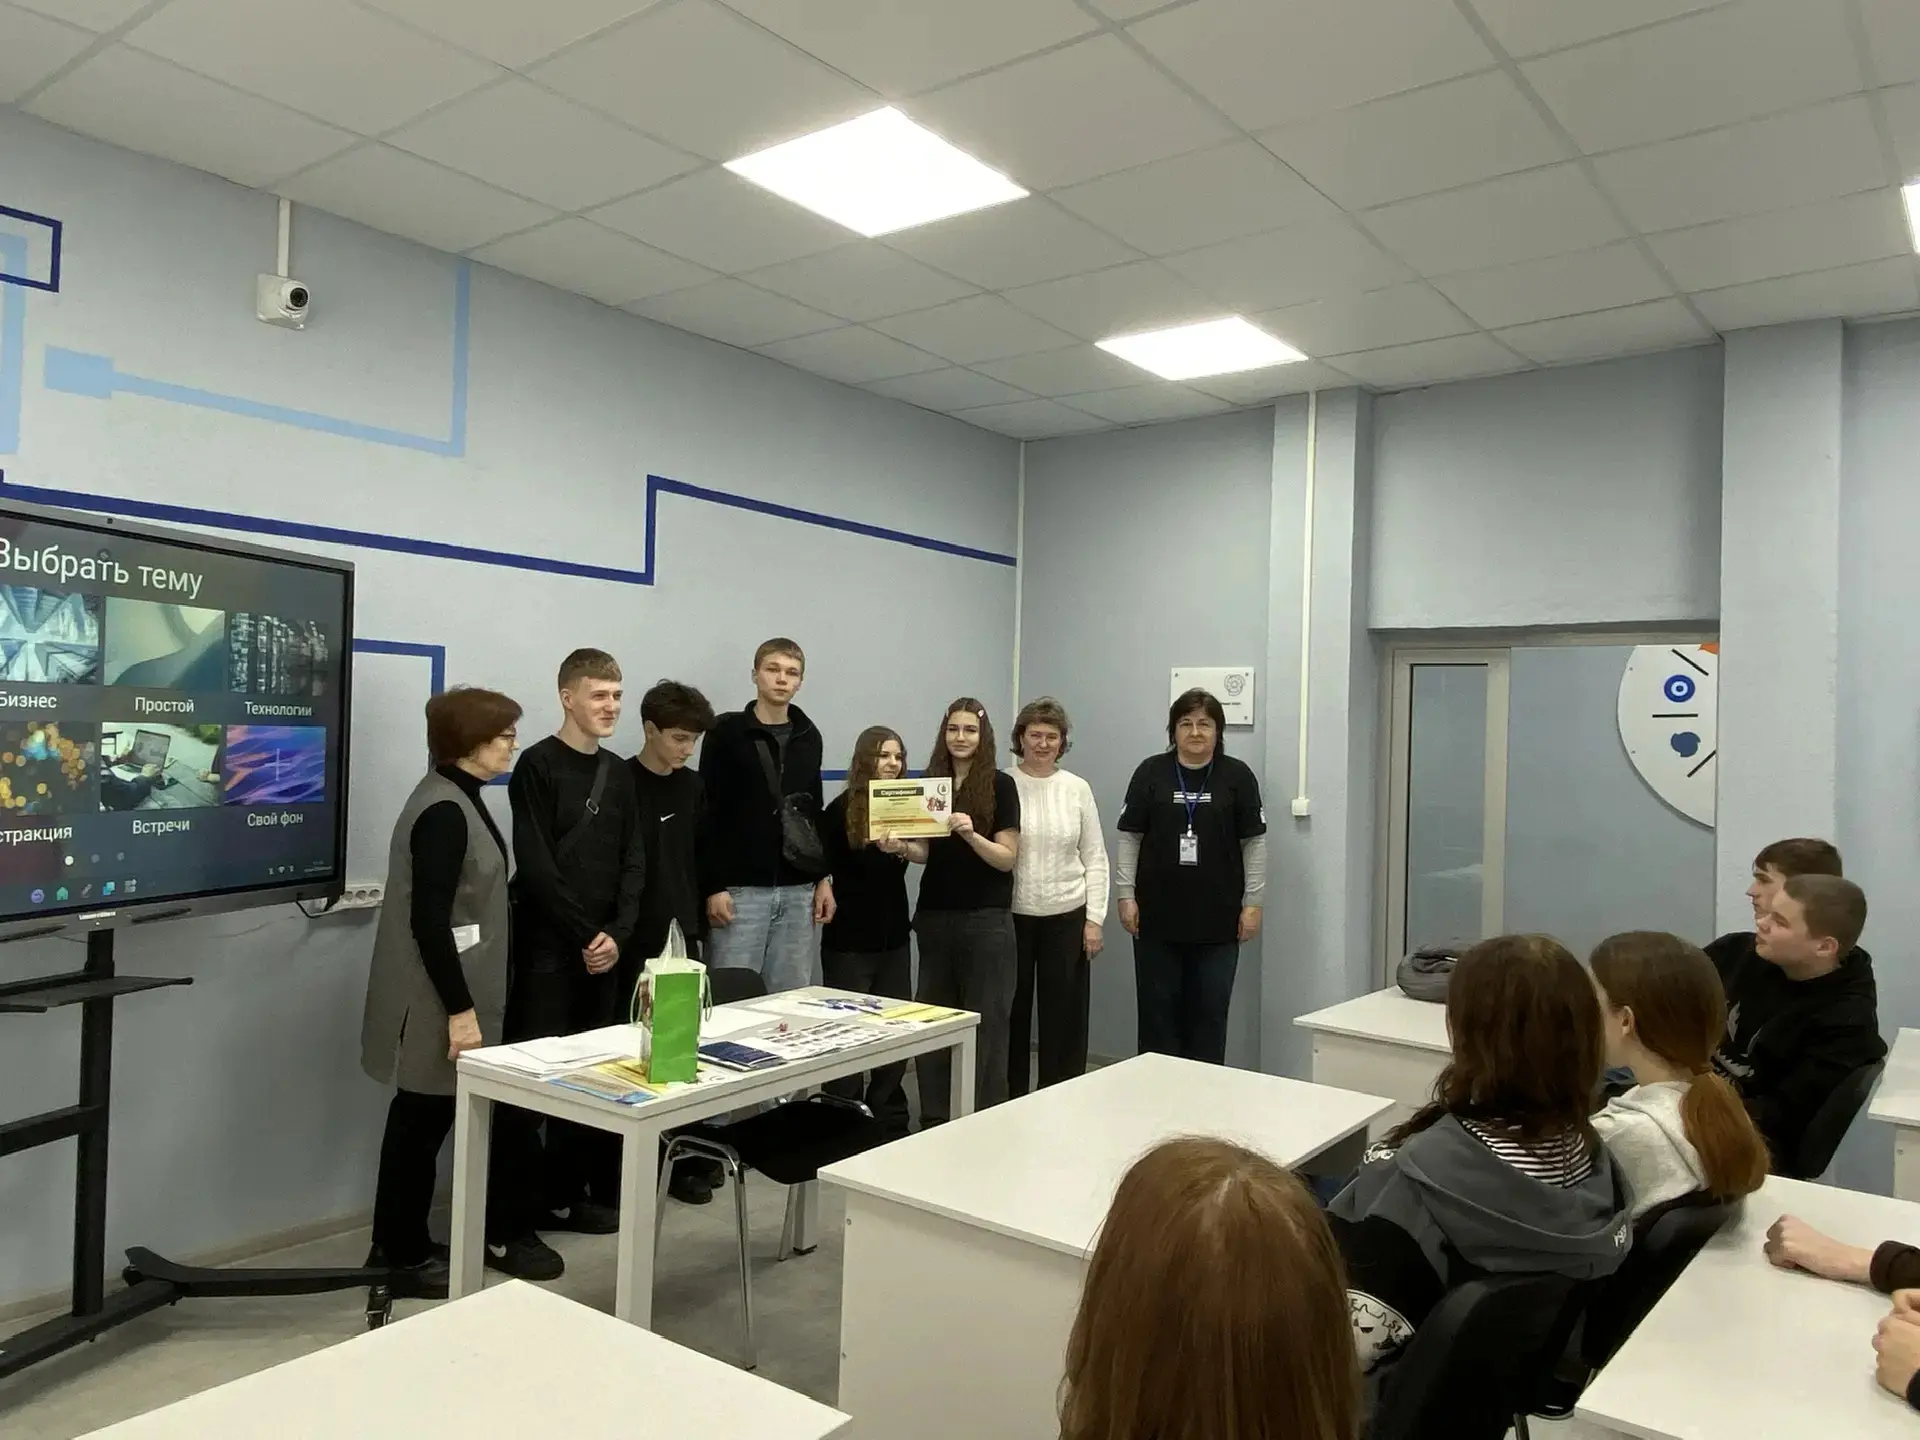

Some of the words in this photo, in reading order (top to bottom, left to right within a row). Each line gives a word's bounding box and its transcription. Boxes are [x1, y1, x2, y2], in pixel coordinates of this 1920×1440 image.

[138, 565, 204, 599] тему
[0, 691, 57, 708] Бизнес
[135, 697, 194, 713] Простой
[244, 701, 312, 717] Технологии
[247, 812, 277, 827] Свой
[281, 811, 303, 828] фон
[133, 820, 190, 837] Встречи
